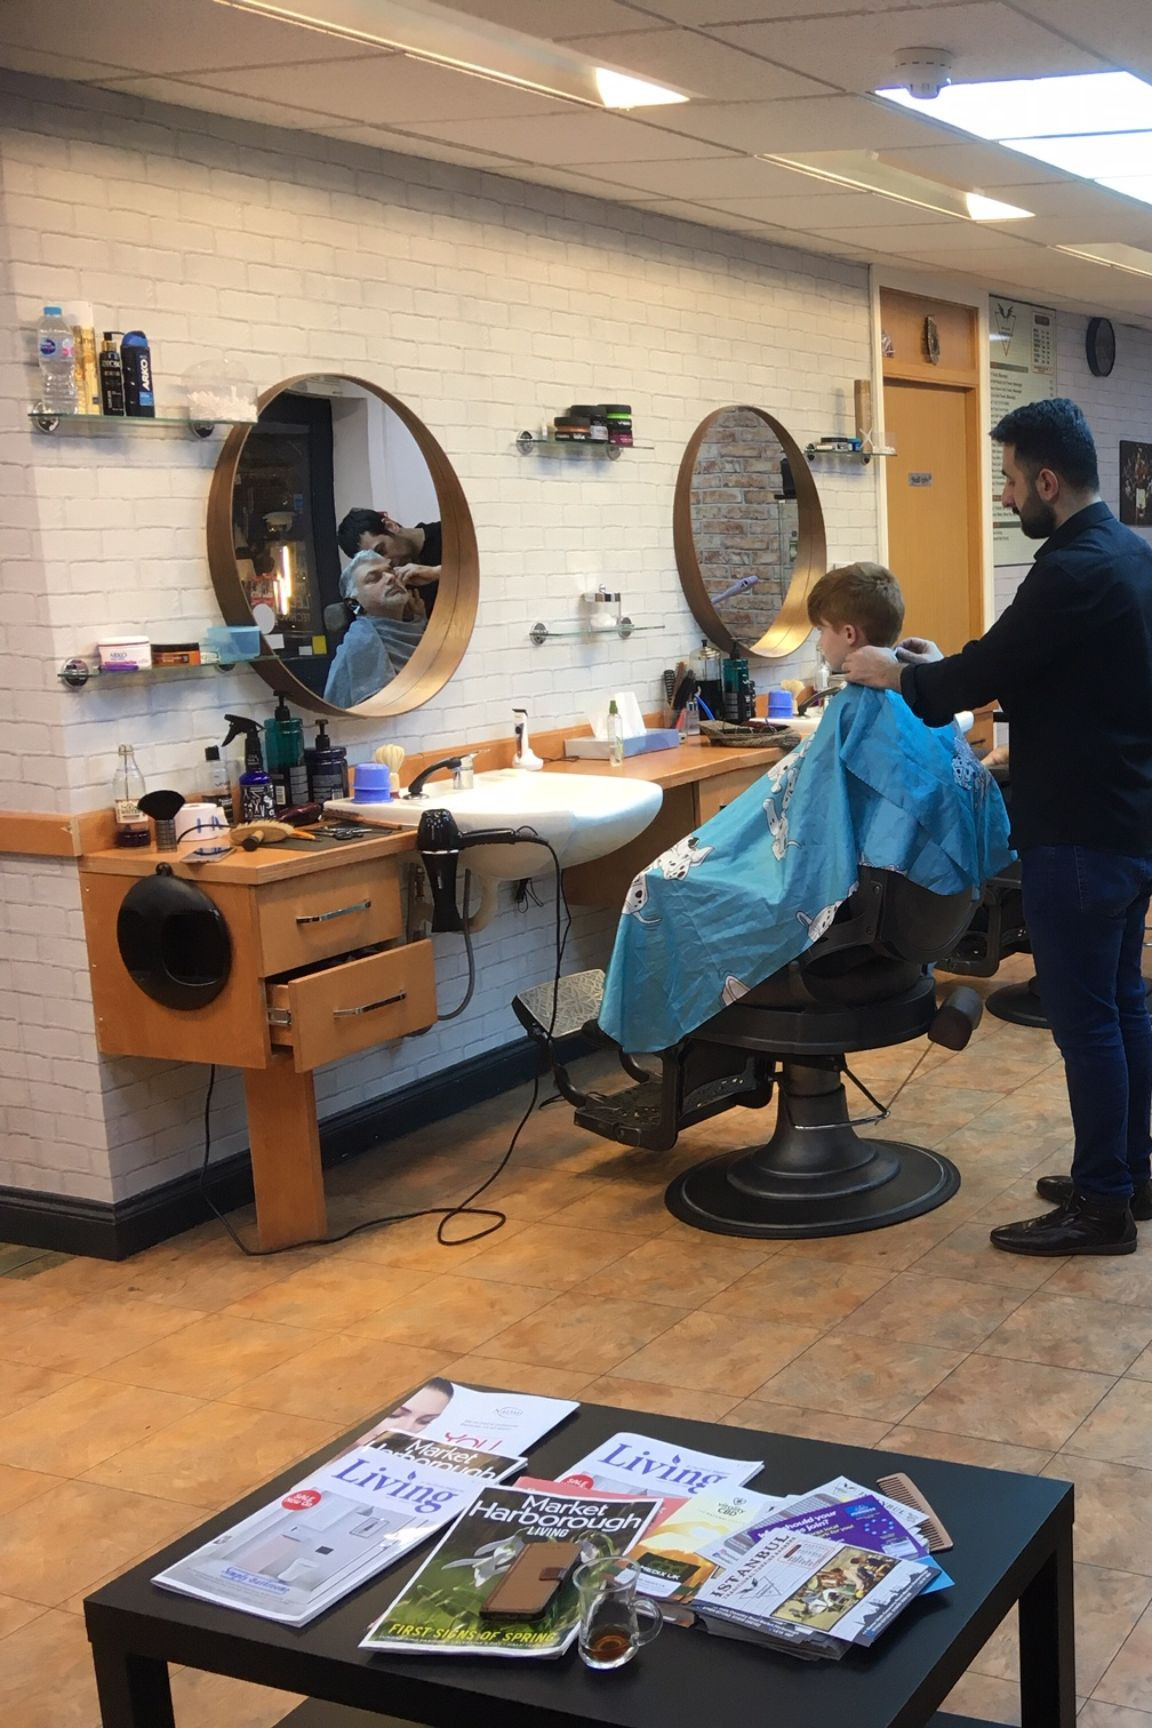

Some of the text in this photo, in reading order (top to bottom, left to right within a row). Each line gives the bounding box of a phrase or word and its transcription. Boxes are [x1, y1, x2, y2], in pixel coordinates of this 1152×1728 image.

[140, 358, 151, 392] ARKO
[404, 1438, 478, 1464] Market
[597, 1443, 728, 1496] Living
[332, 1458, 459, 1514] Living
[566, 1478, 590, 1488] SALE
[468, 1499, 642, 1533] Harborough
[521, 1495, 609, 1517] Market
[717, 1508, 738, 1517] CBD
[814, 1510, 838, 1523] your
[527, 1525, 571, 1538] LIVING
[804, 1518, 830, 1532] join?
[710, 1535, 790, 1598] ISTANBUL
[388, 1623, 433, 1638] FIRST
[433, 1627, 479, 1641] SIGNS
[479, 1630, 500, 1642] OF
[502, 1632, 558, 1643] SPRING
